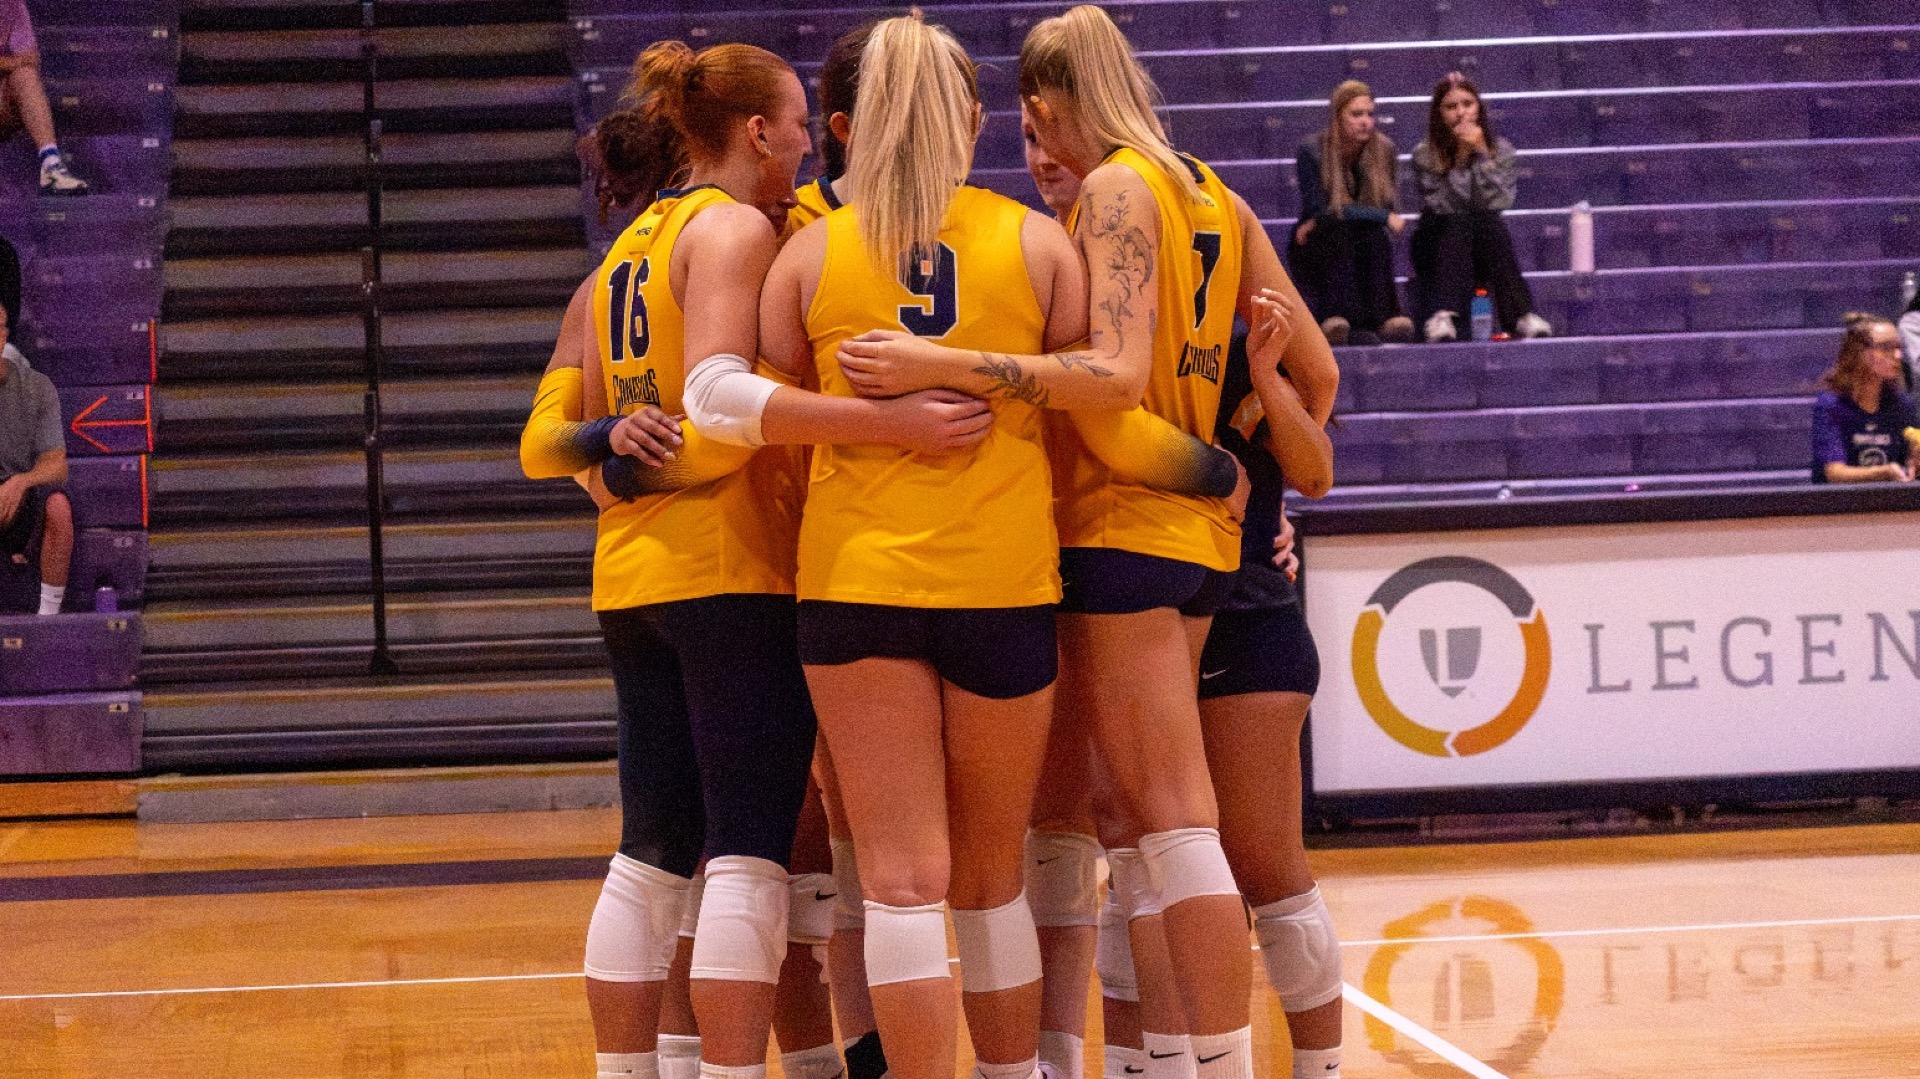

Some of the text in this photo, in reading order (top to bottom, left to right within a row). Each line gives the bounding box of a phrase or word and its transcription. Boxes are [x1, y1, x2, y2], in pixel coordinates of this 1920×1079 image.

[607, 255, 651, 364] 16
[897, 239, 959, 339] 9
[1191, 230, 1221, 332] 7
[1583, 609, 1920, 694] LEGEN
